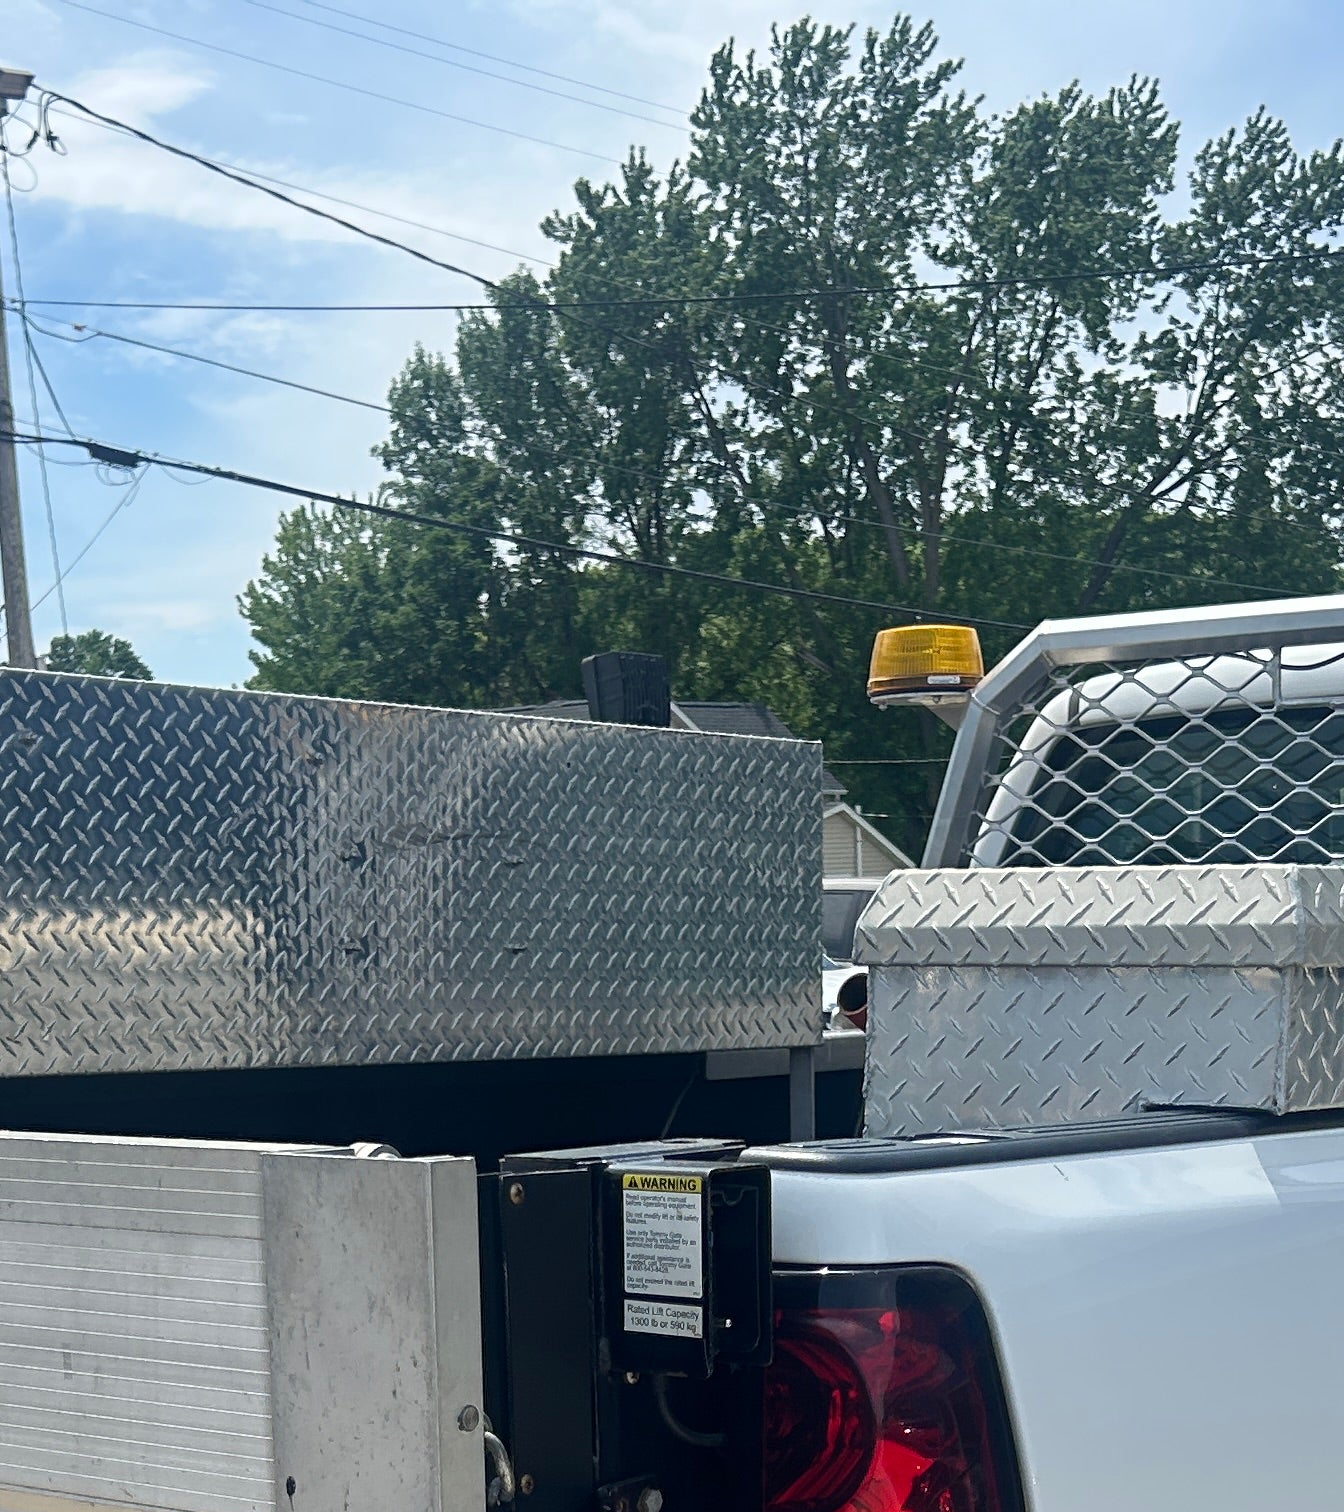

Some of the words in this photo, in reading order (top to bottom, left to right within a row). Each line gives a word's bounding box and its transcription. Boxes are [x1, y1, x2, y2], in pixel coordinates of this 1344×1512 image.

[640, 1176, 697, 1191] WARNING
[627, 1304, 649, 1315] Rated
[666, 1308, 699, 1322] Capacity
